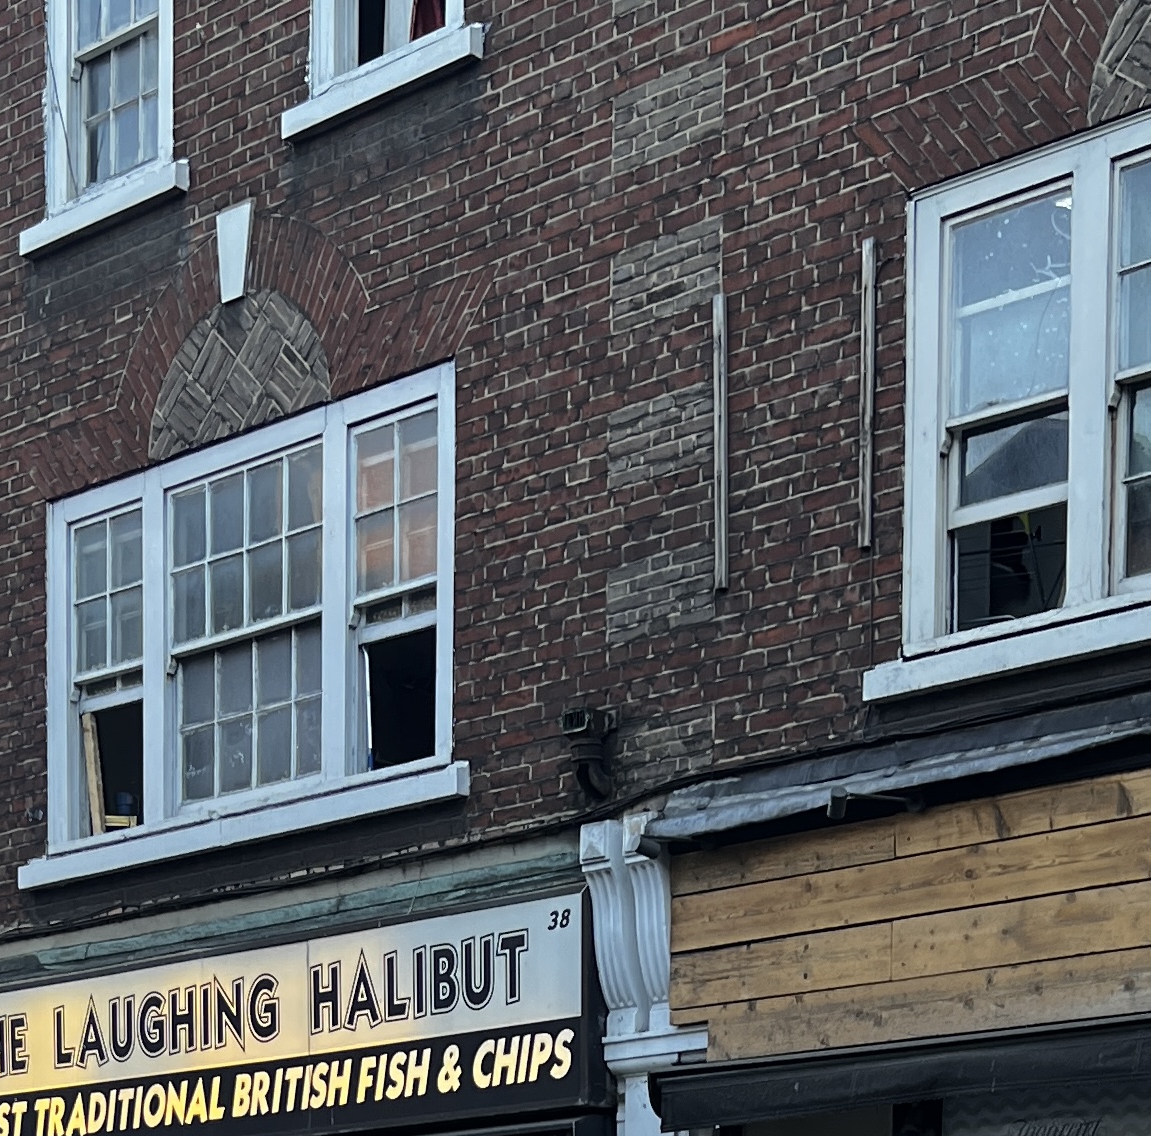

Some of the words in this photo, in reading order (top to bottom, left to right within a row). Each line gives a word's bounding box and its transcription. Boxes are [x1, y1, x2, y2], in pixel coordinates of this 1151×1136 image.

[547, 908, 571, 932] 38
[52, 973, 280, 1070] LAUGHING
[309, 928, 530, 1035] HALIBUT
[231, 1061, 351, 1119] BRITISH
[356, 1048, 429, 1104] FISH
[436, 1050, 462, 1092] &
[472, 1028, 576, 1092] CHIPS
